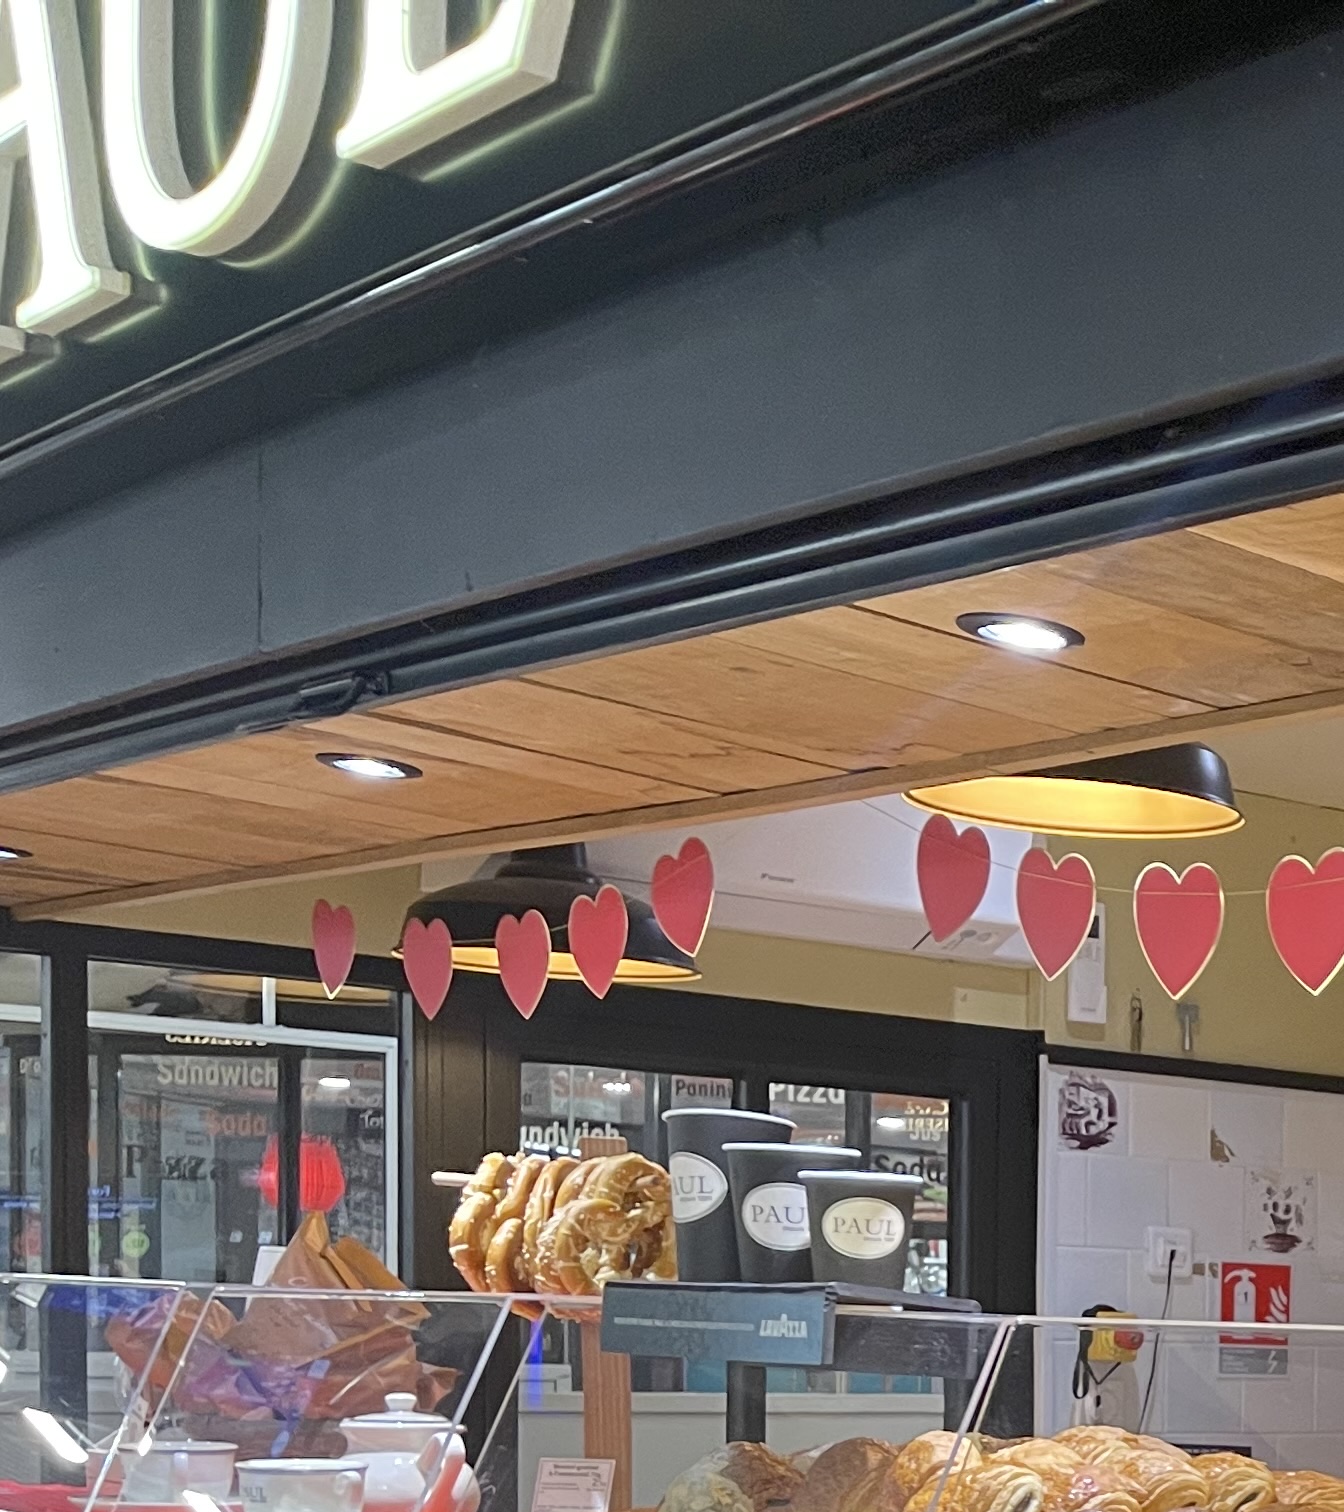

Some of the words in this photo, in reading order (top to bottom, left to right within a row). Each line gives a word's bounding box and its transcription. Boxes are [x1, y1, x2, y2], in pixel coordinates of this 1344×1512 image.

[157, 1059, 278, 1088] Sandwich
[674, 1176, 713, 1197] AUL
[751, 1205, 806, 1225] PAU
[833, 1217, 897, 1236] PAUL
